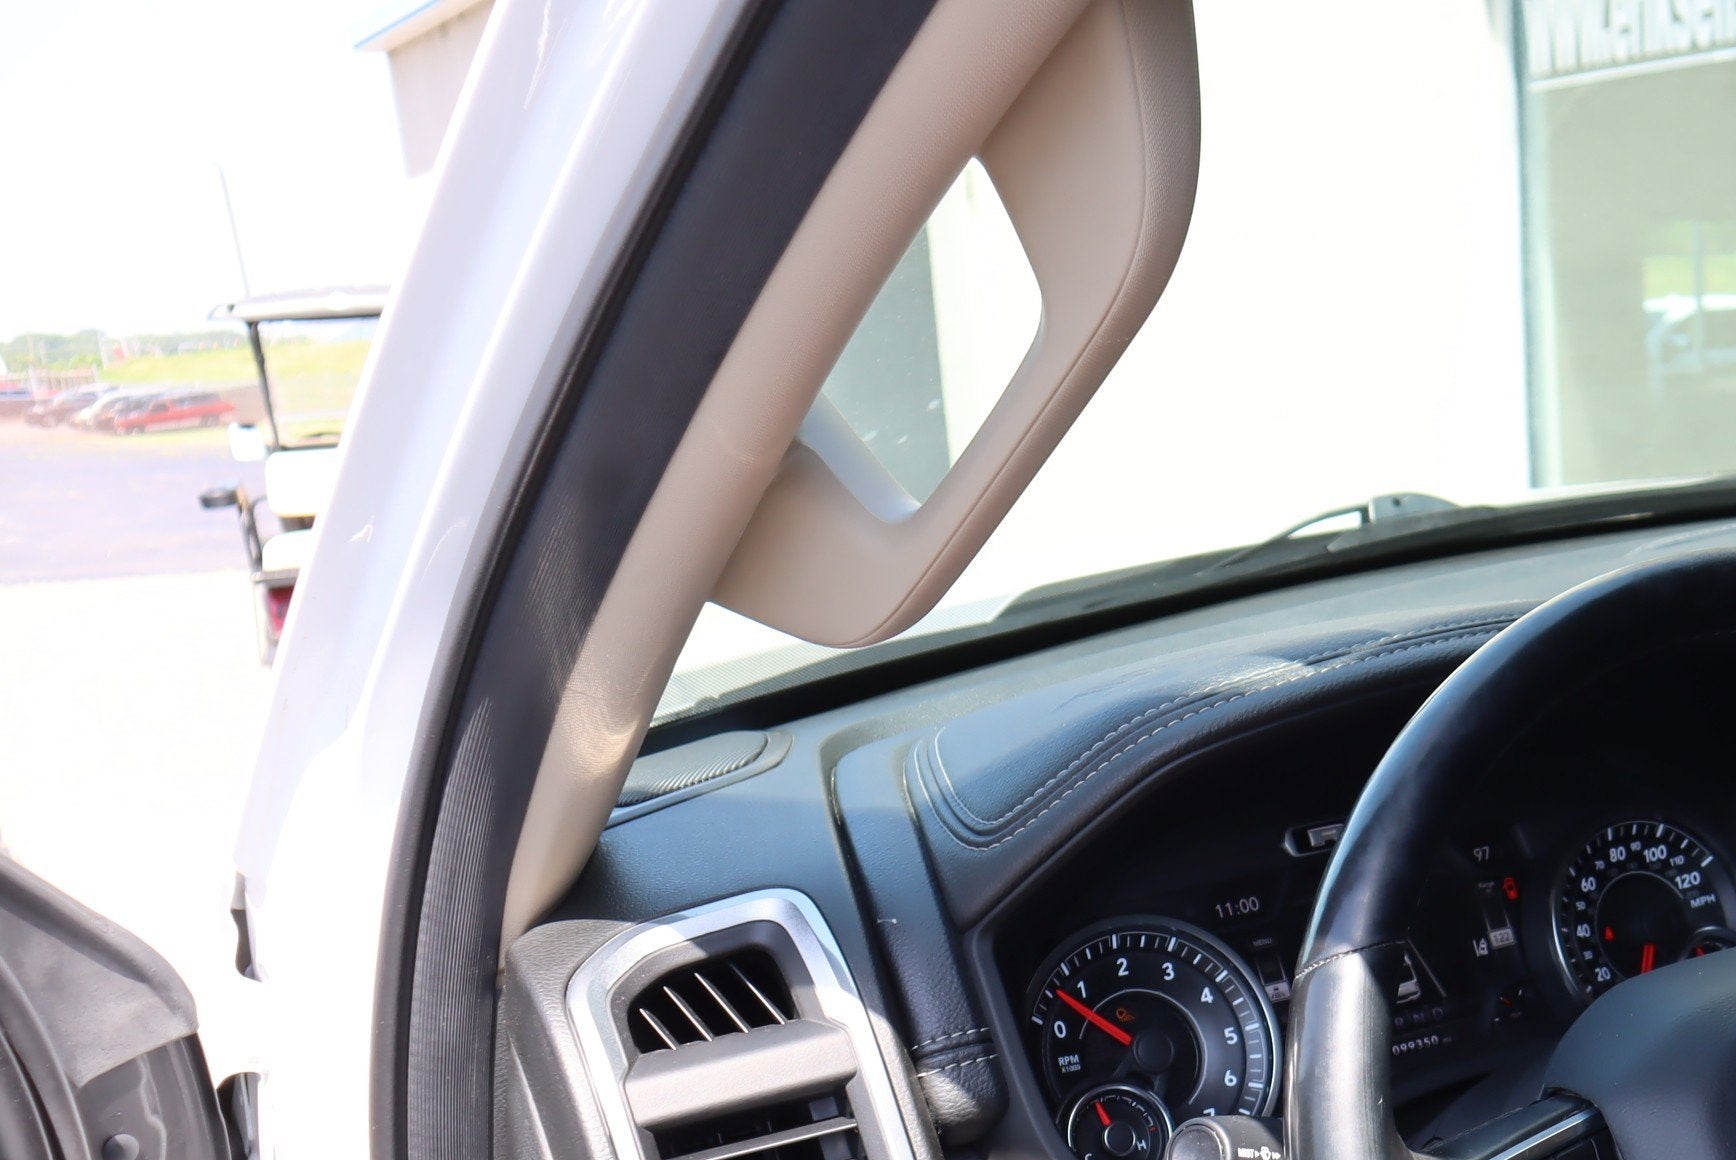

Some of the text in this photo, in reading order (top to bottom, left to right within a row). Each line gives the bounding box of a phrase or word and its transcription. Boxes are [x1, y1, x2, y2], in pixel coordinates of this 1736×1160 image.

[1473, 846, 1490, 861] 97
[1609, 846, 1626, 863] 80
[1630, 841, 1641, 851] 90
[1643, 845, 1667, 863] 100
[1581, 877, 1597, 892] 60
[1675, 871, 1701, 889] 120
[1215, 896, 1259, 919] 11:00
[1690, 893, 1716, 909] MPH
[1576, 923, 1591, 938] 40
[1116, 957, 1129, 977] 2
[1162, 962, 1175, 981] 3
[1595, 966, 1612, 982] 20
[1077, 981, 1087, 998] 1
[1200, 986, 1213, 1004] 4
[1053, 1020, 1067, 1039] 0
[1224, 1026, 1237, 1045] 5
[1058, 1054, 1080, 1067] RPM
[1224, 1069, 1237, 1087] 6
[1137, 1138, 1147, 1151] H
